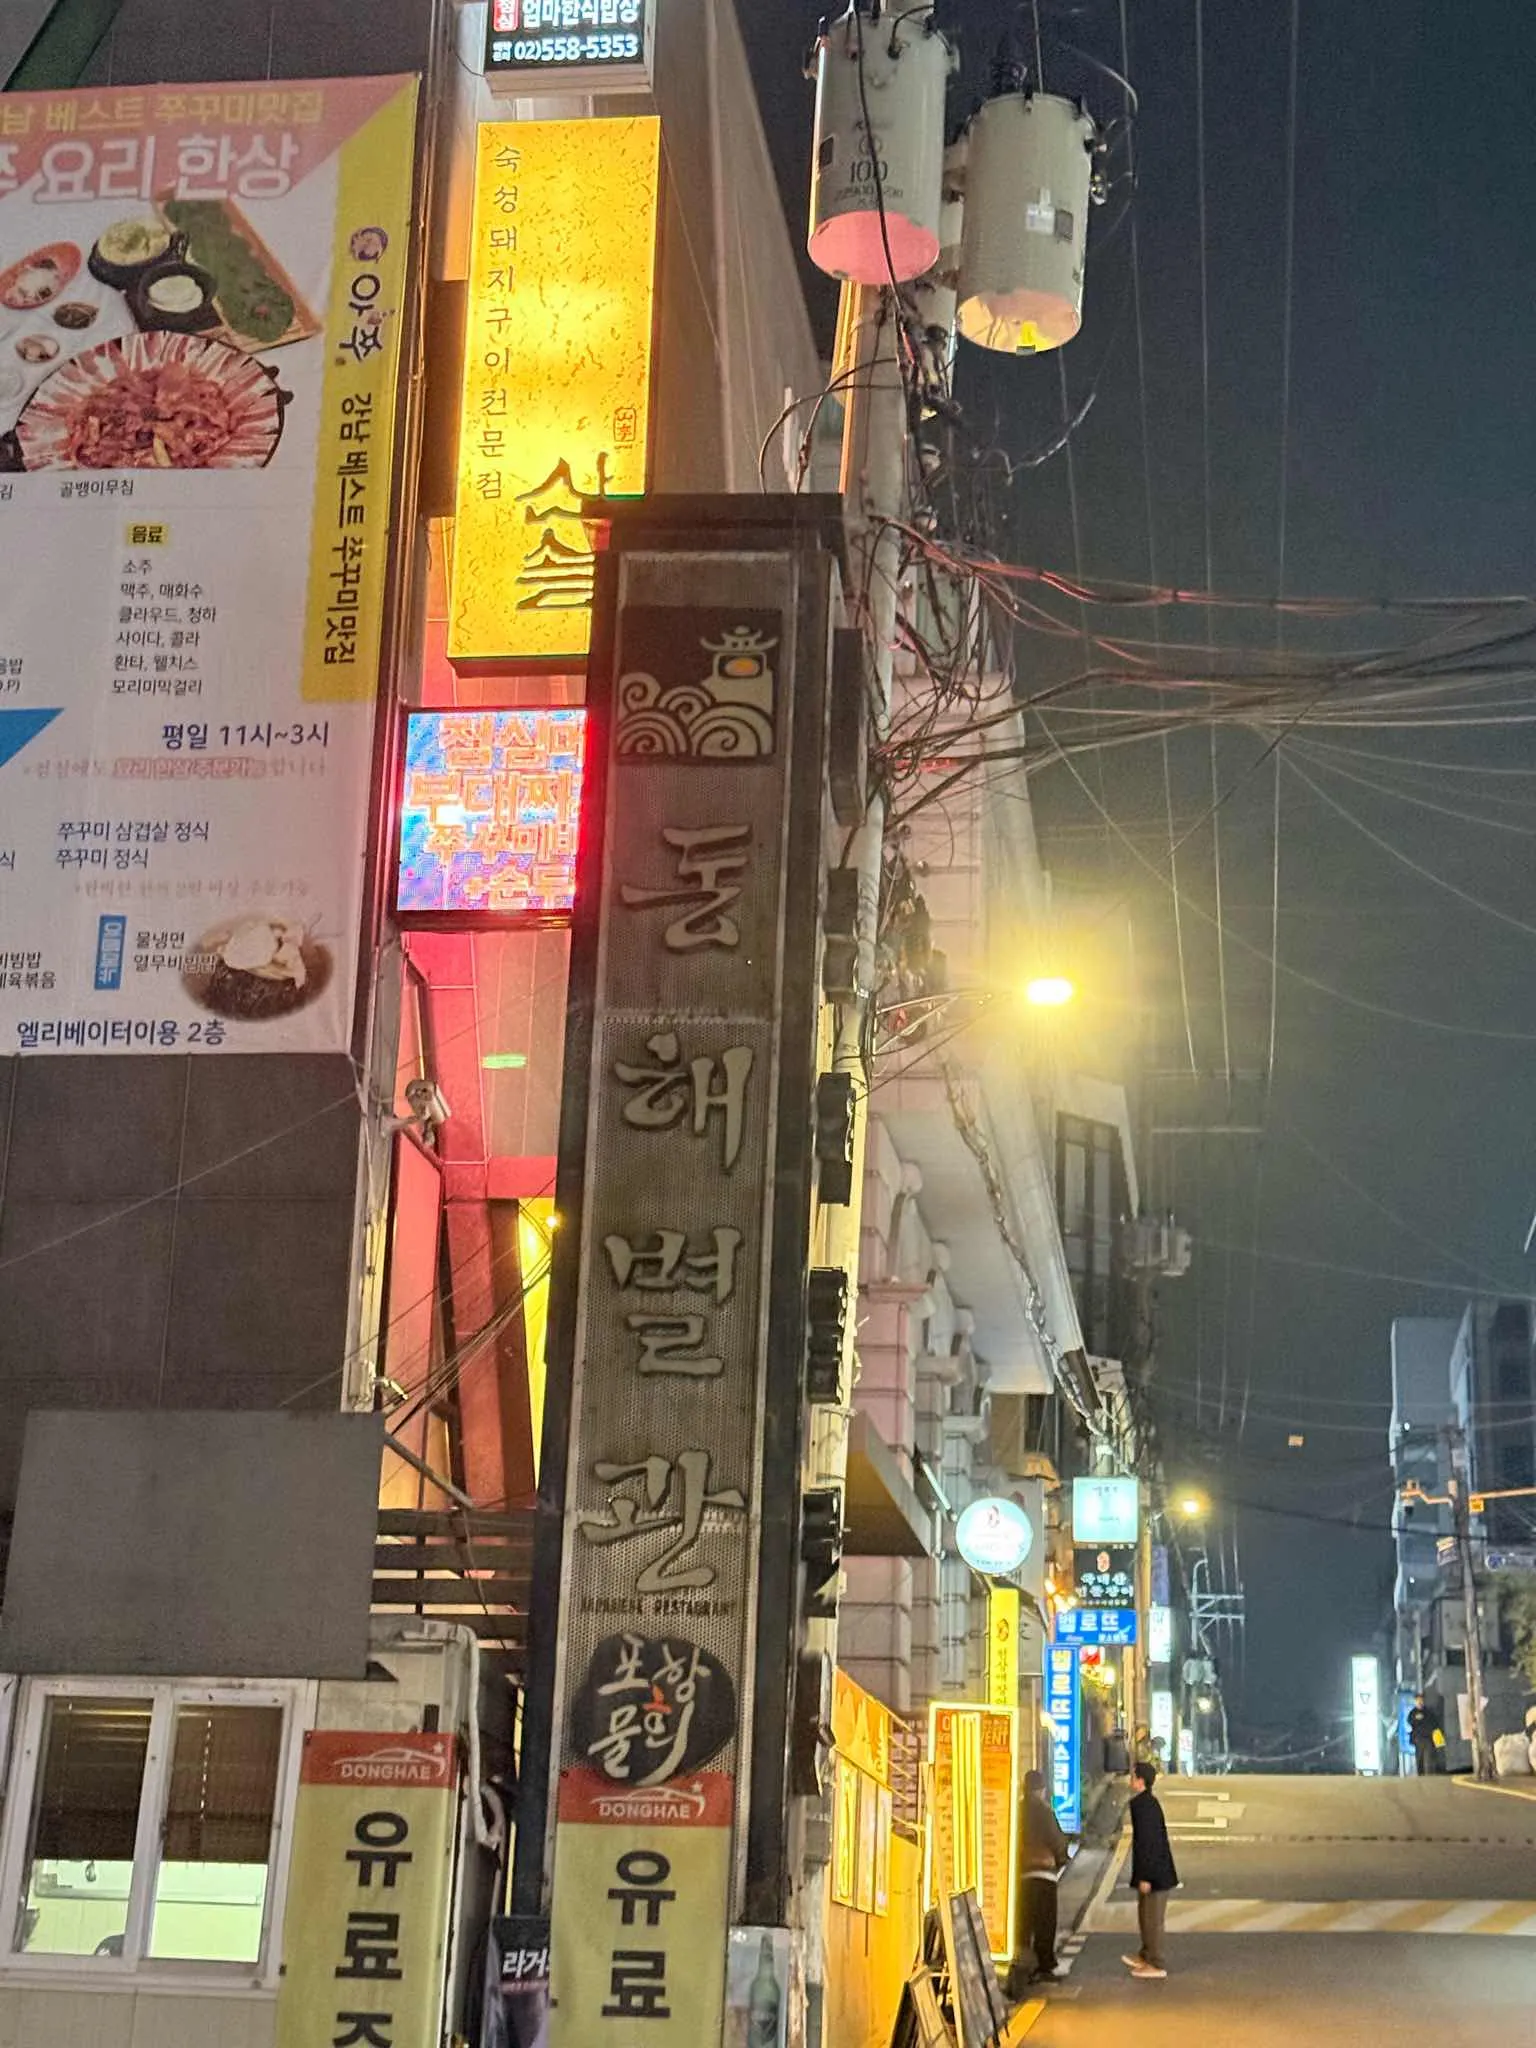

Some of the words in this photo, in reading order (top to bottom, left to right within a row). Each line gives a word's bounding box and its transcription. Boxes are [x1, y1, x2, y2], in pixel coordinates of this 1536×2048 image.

[514, 34, 639, 61] 02)558-5353
[46, 95, 145, 133] 베스트
[32, 134, 154, 204] 요리
[176, 130, 300, 201] 한상
[340, 391, 373, 444] 강남
[60, 480, 134, 497] 골뱅이무침
[337, 450, 369, 529] 베스트
[132, 525, 163, 544] 음료
[122, 559, 153, 575] 소주
[120, 583, 154, 600] 맥주,
[159, 583, 204, 600] 매화수
[324, 535, 364, 665] 쭈꾸미맛집
[118, 606, 182, 624] 클라우드,
[188, 607, 216, 623] 청하
[116, 631, 165, 647] 사이다,
[170, 631, 200, 646] 콜라
[114, 655, 149, 671] 환타,
[153, 655, 199, 671] 웰치스
[162, 723, 208, 750] 평일
[219, 721, 329, 748] 11시~3시
[58, 822, 110, 841] 쭈꾸미
[115, 821, 168, 842] 삼겹살
[174, 821, 209, 842] 정식
[55, 850, 107, 870] 쭈꾸미
[113, 849, 148, 869] 정식
[136, 931, 185, 949] 물냉면
[17, 1020, 180, 1048] 엘리베이터이용
[187, 1021, 227, 1046] 2층
[340, 1763, 421, 1780] DONGHAE
[600, 1802, 690, 1819] DONGHAE
[601, 1850, 677, 2018] 유료
[502, 1947, 548, 1977] 라거
